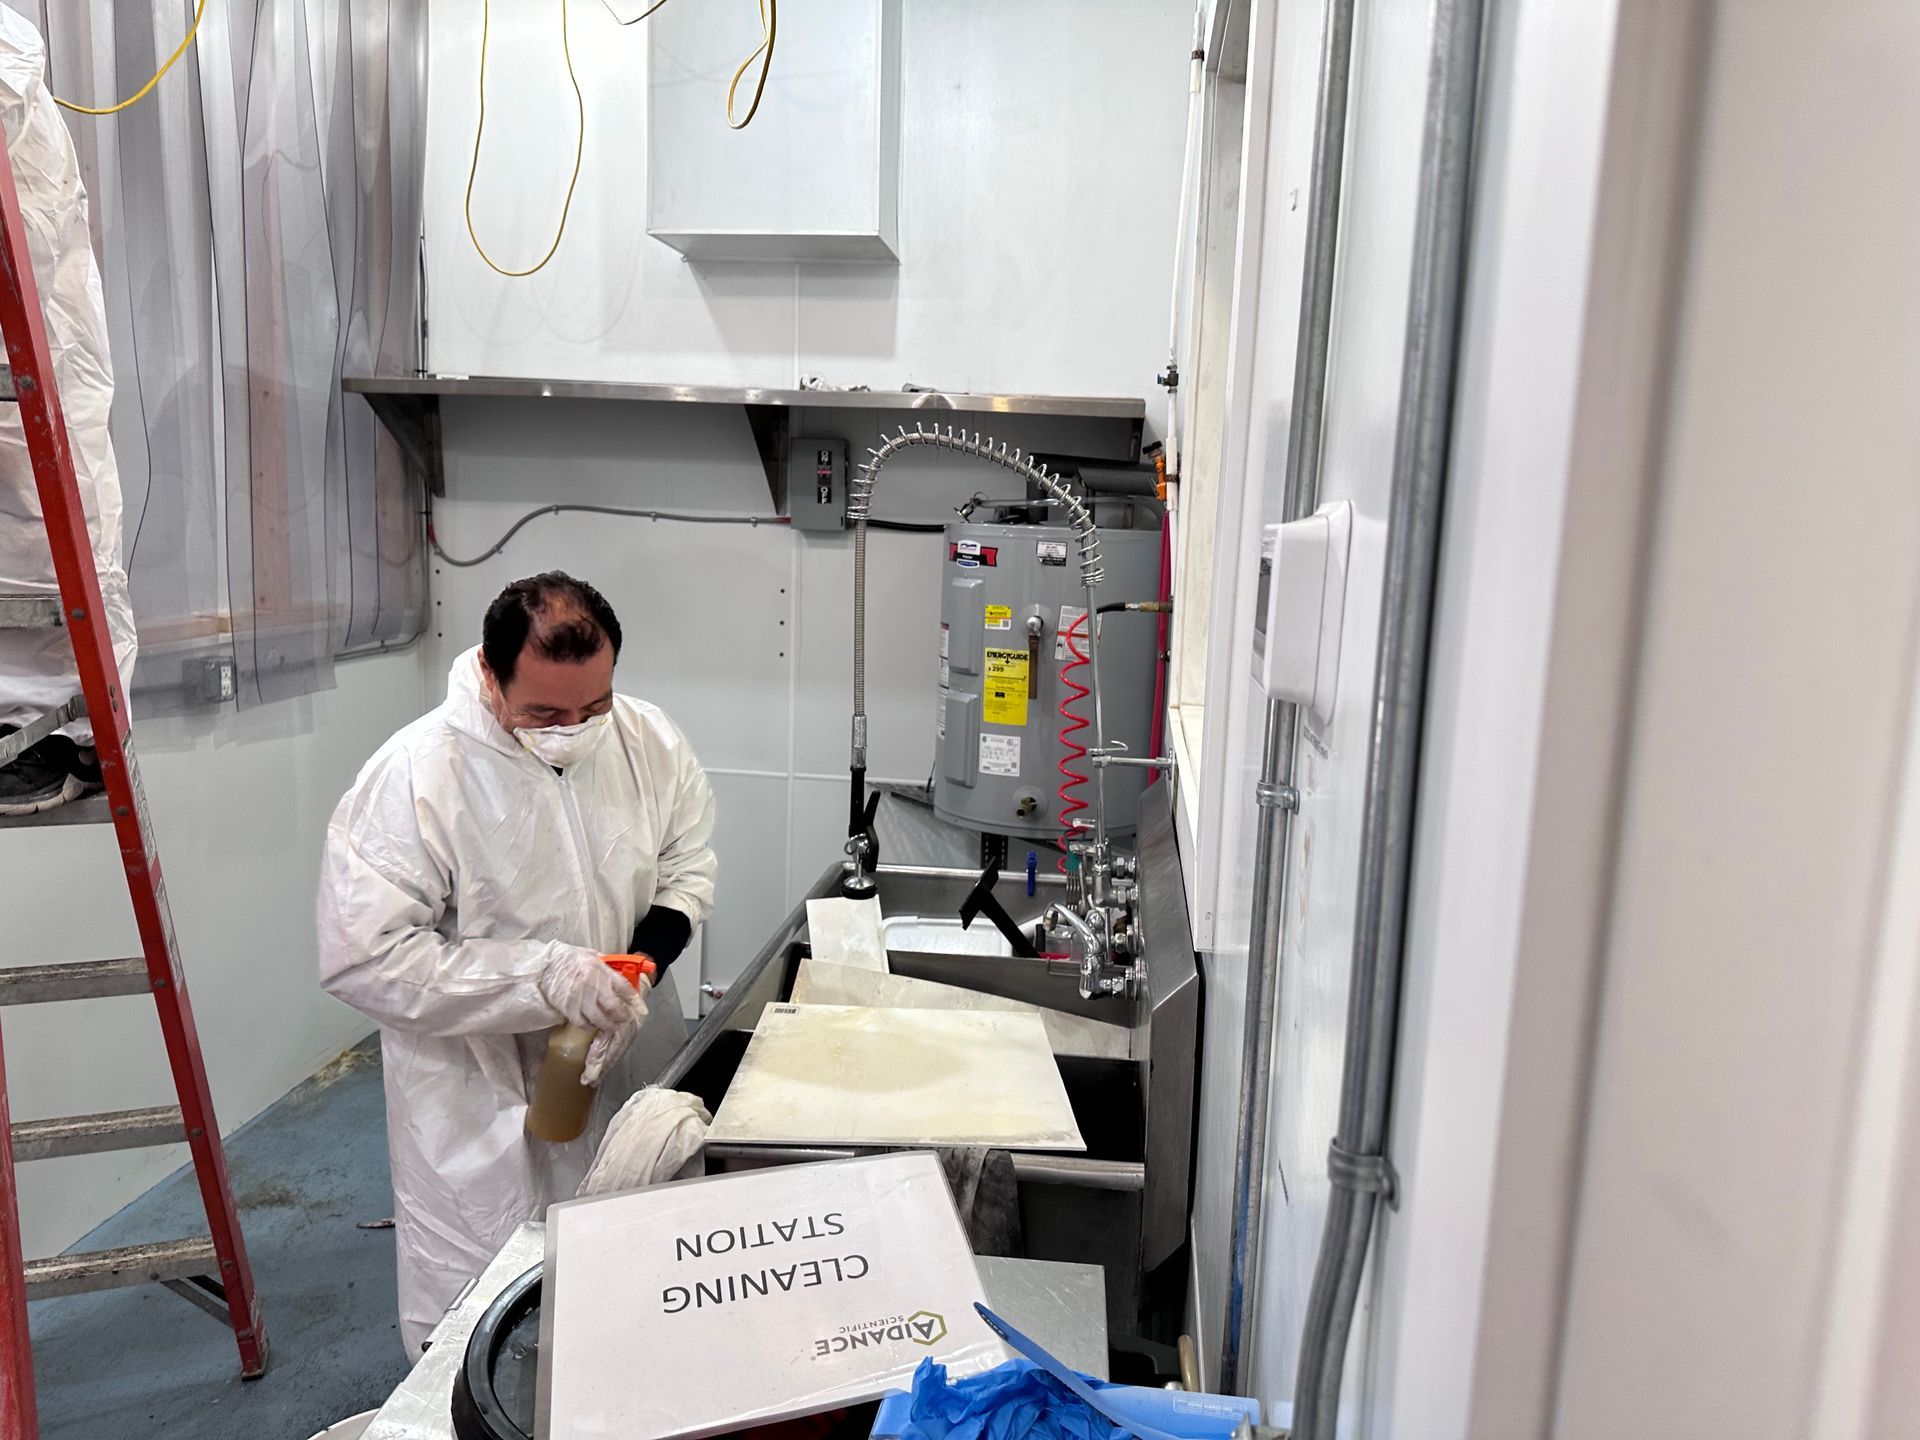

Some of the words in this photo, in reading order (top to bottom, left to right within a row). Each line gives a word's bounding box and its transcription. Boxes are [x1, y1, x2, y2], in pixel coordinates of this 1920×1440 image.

[675, 1212, 845, 1262] STATION
[662, 1254, 869, 1314] CLEANING
[815, 1318, 935, 1356] AIDANCE
[839, 1315, 904, 1333] SCIENTIFIC
